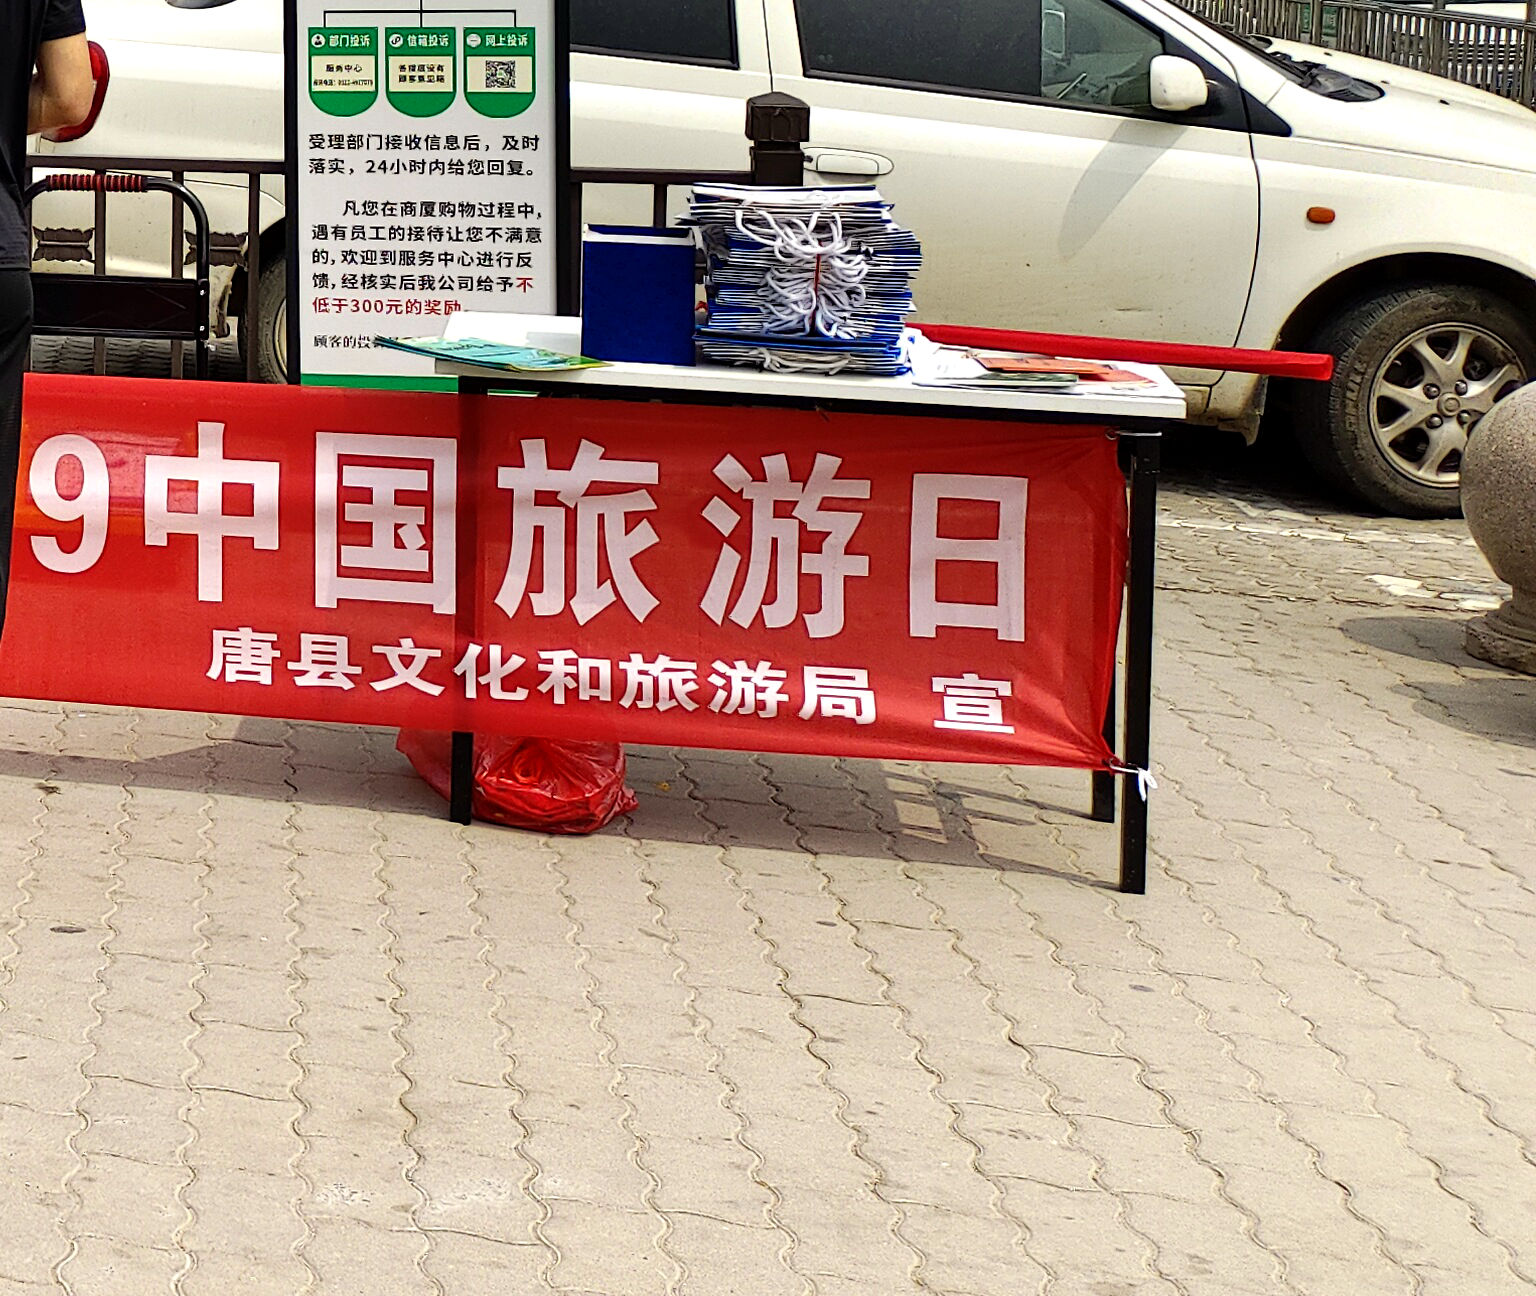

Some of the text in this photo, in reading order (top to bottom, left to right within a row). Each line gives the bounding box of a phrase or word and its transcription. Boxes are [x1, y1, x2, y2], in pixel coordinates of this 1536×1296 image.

[328, 33, 371, 48] 部门投诉
[406, 33, 450, 48] 信箱投诉
[484, 33, 529, 48] 网上投诉
[308, 133, 541, 152] 受理部门接收信息后，及时
[308, 157, 536, 177] 落实，24小时内给您回复。
[342, 200, 543, 220] 凡您在商厦购物过程中，
[311, 224, 543, 245] 遇有员工的接待让您不满意
[311, 249, 533, 269] 的，欢迎到服务中心进行反
[311, 272, 534, 294] 馈，经核实后我公司给予不
[206, 626, 1016, 736] 唐县文化和旅游局 宣
